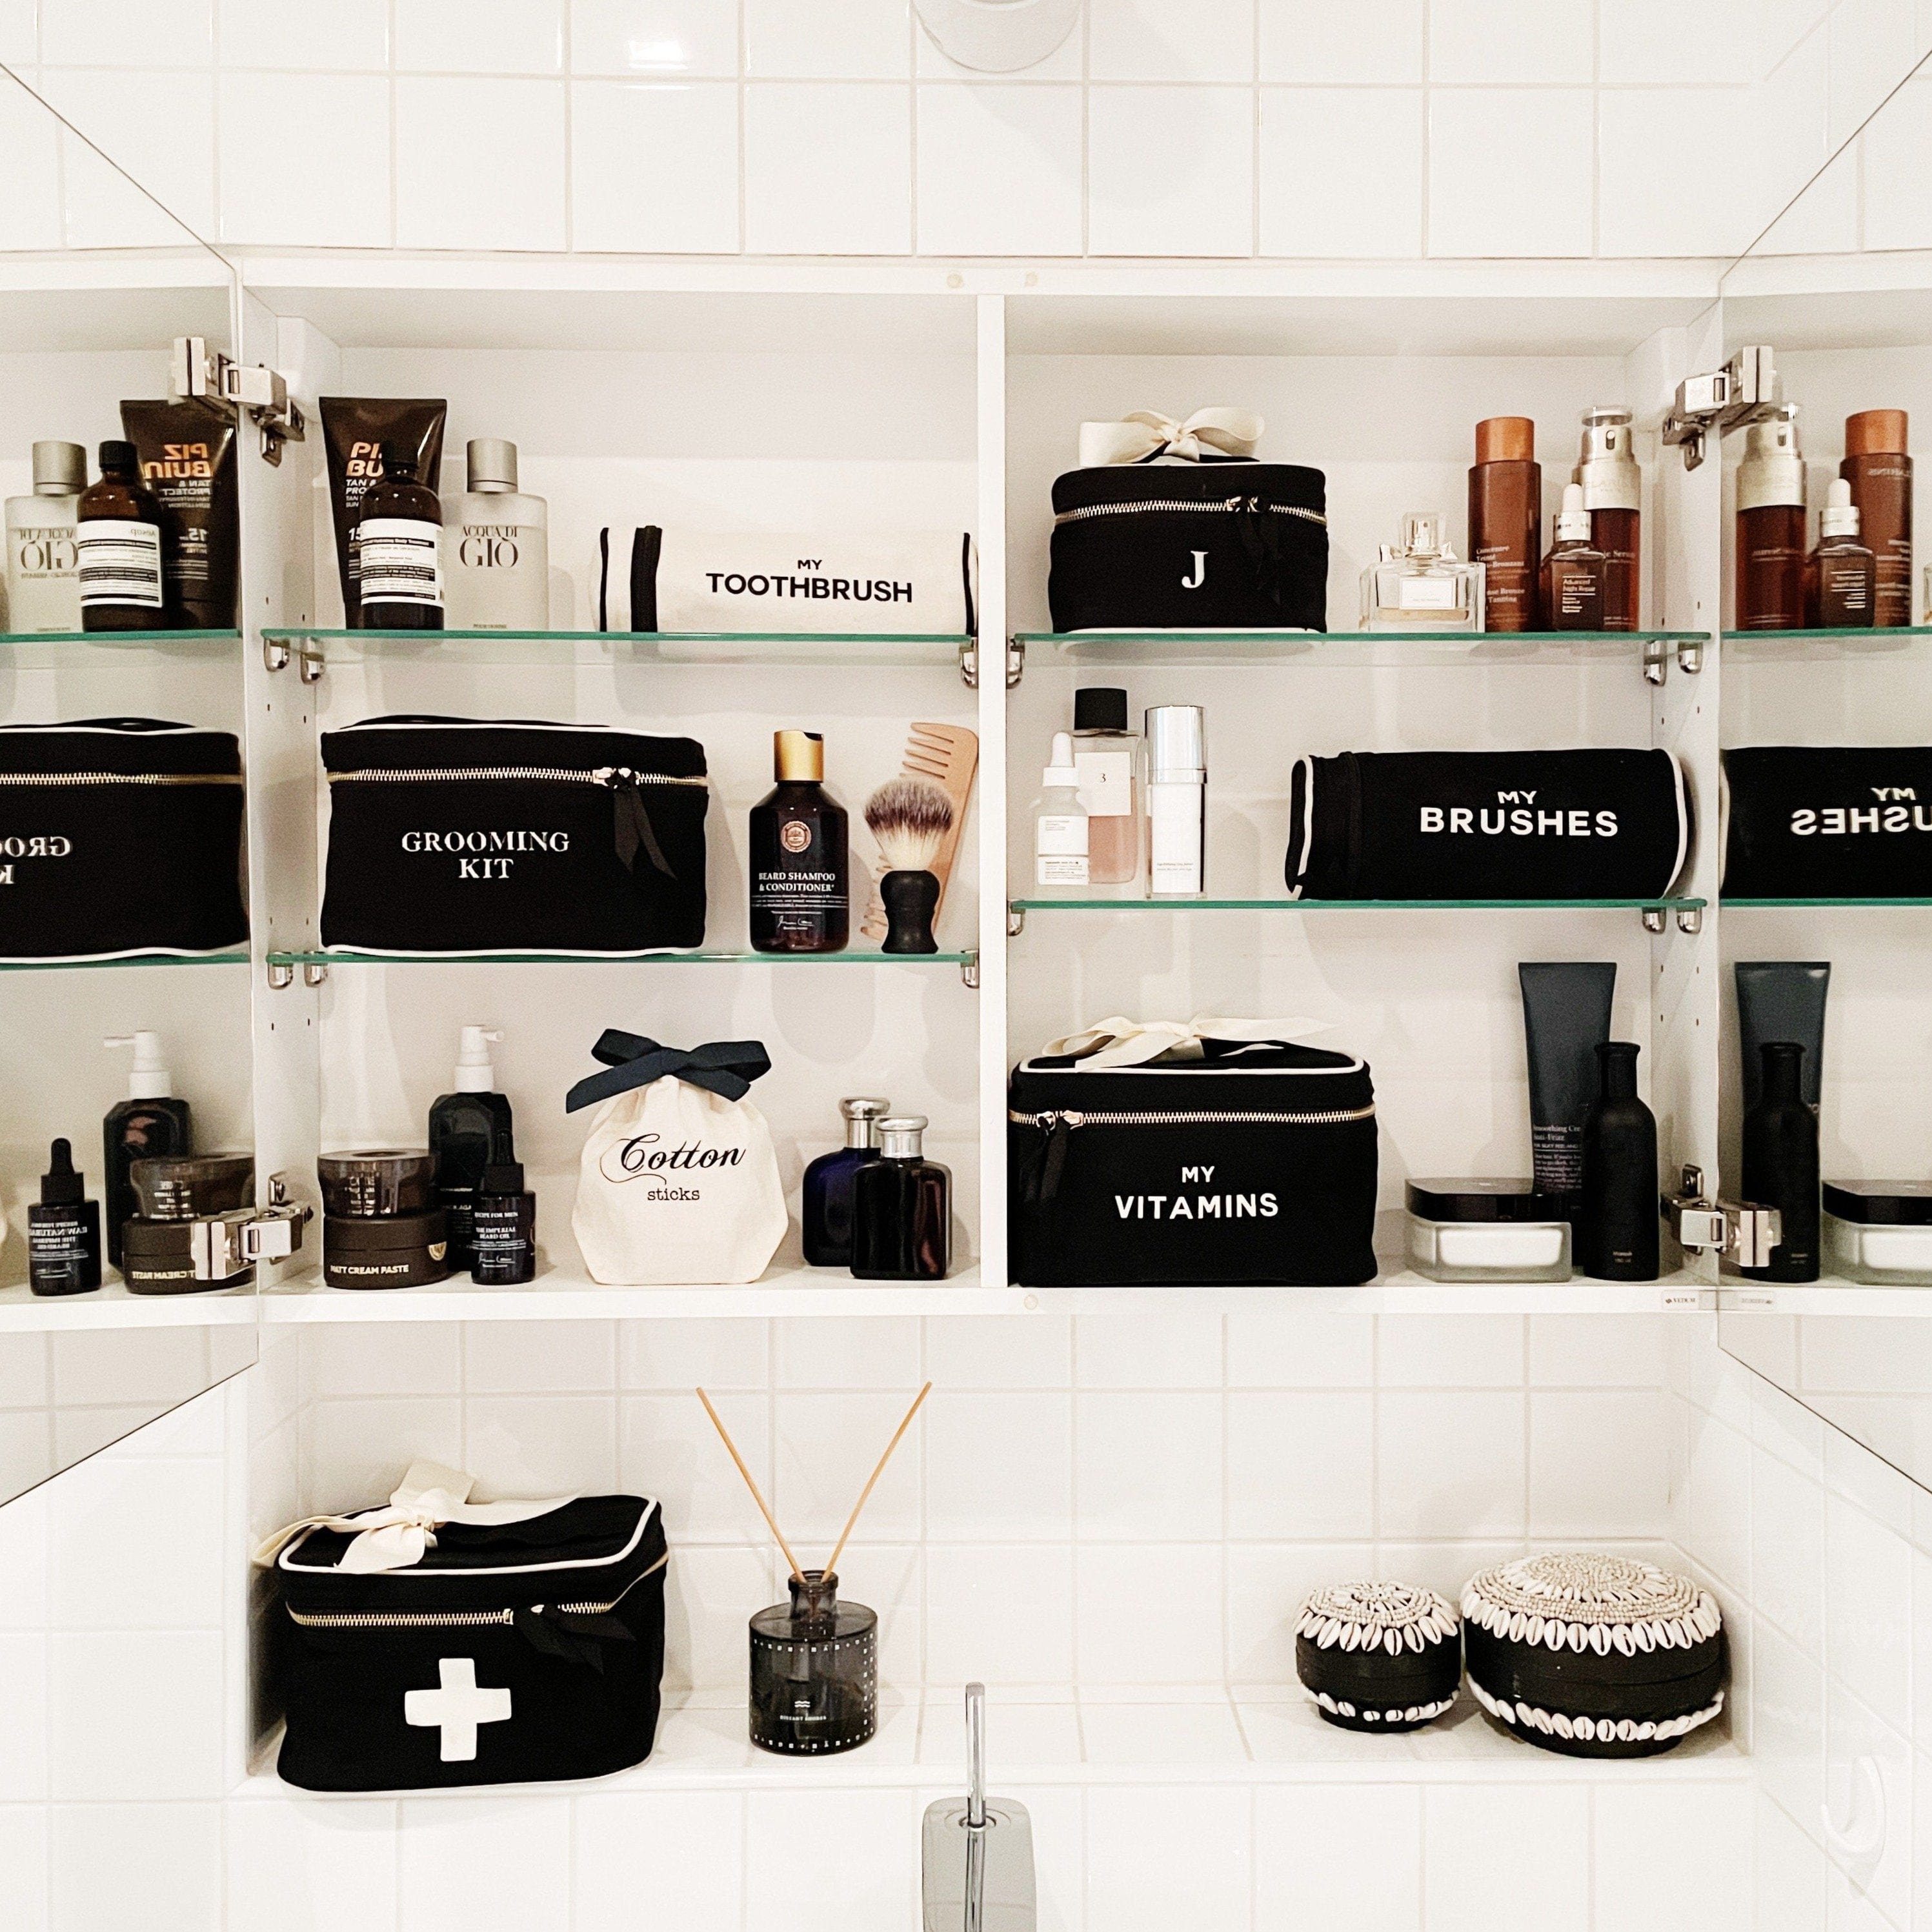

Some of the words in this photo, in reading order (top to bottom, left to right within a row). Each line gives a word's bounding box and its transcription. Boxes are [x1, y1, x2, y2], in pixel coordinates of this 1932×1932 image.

[350, 442, 382, 459] PI
[346, 459, 383, 476] BU
[461, 525, 501, 538] ACQUA
[505, 526, 518, 538] DI
[459, 537, 518, 568] GIÒ
[798, 559, 823, 570] MY
[1182, 551, 1208, 588] J
[705, 573, 912, 603] TOOTHBRUSH
[1100, 772, 1106, 783] 3
[1497, 790, 1537, 805] MY
[1420, 807, 1618, 837] BRUSHES
[401, 831, 570, 852] GROOMING
[459, 858, 514, 879] KIT
[788, 872, 836, 881] SHAMPOO
[600, 1134, 746, 1184] Cotton
[1182, 1165, 1215, 1183] MY
[647, 1187, 700, 1201] sticks
[1114, 1192, 1278, 1220] VITAMINS
[348, 1266, 379, 1274] CREAM
[381, 1265, 409, 1274] PASTE
